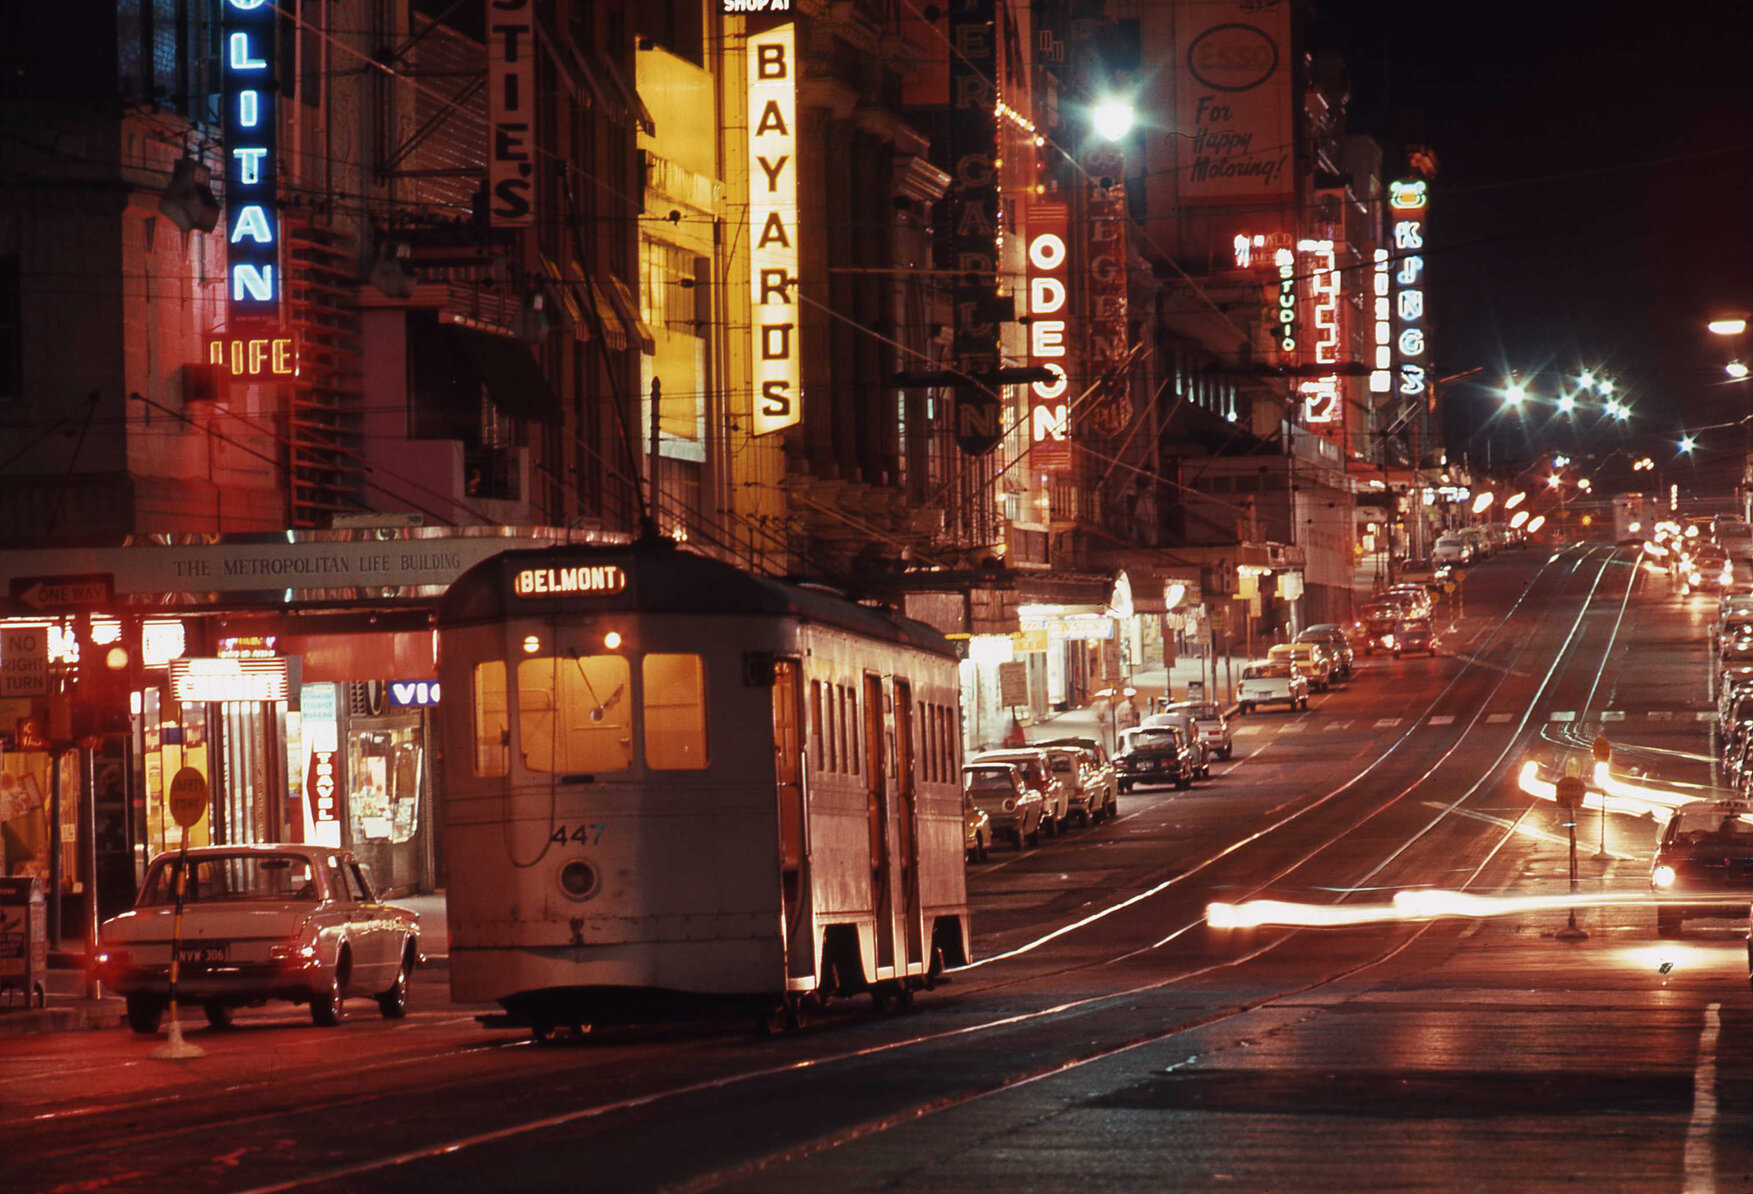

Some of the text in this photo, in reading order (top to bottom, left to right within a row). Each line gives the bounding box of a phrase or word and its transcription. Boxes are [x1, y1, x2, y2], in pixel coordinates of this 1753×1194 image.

[492, 0, 532, 219] TIE'S
[1195, 96, 1232, 124] For
[229, 0, 272, 301] LITAN
[1193, 128, 1253, 155] Happy
[1190, 154, 1288, 186] Motoring!
[755, 43, 794, 417] BAYARDS
[1279, 265, 1295, 352] STUDIO
[1395, 221, 1425, 395] KINGS
[1028, 233, 1069, 441] ODEON
[174, 554, 460, 577] THE METROPOLITAN LIFE BUILDING
[520, 566, 617, 592] BELMONT
[38, 586, 103, 602] ONE WAY
[8, 636, 37, 652] NO
[2, 657, 44, 673] RIGHT
[5, 675, 44, 691] TURN
[316, 752, 334, 821] TRAVEL
[551, 823, 606, 847] 447
